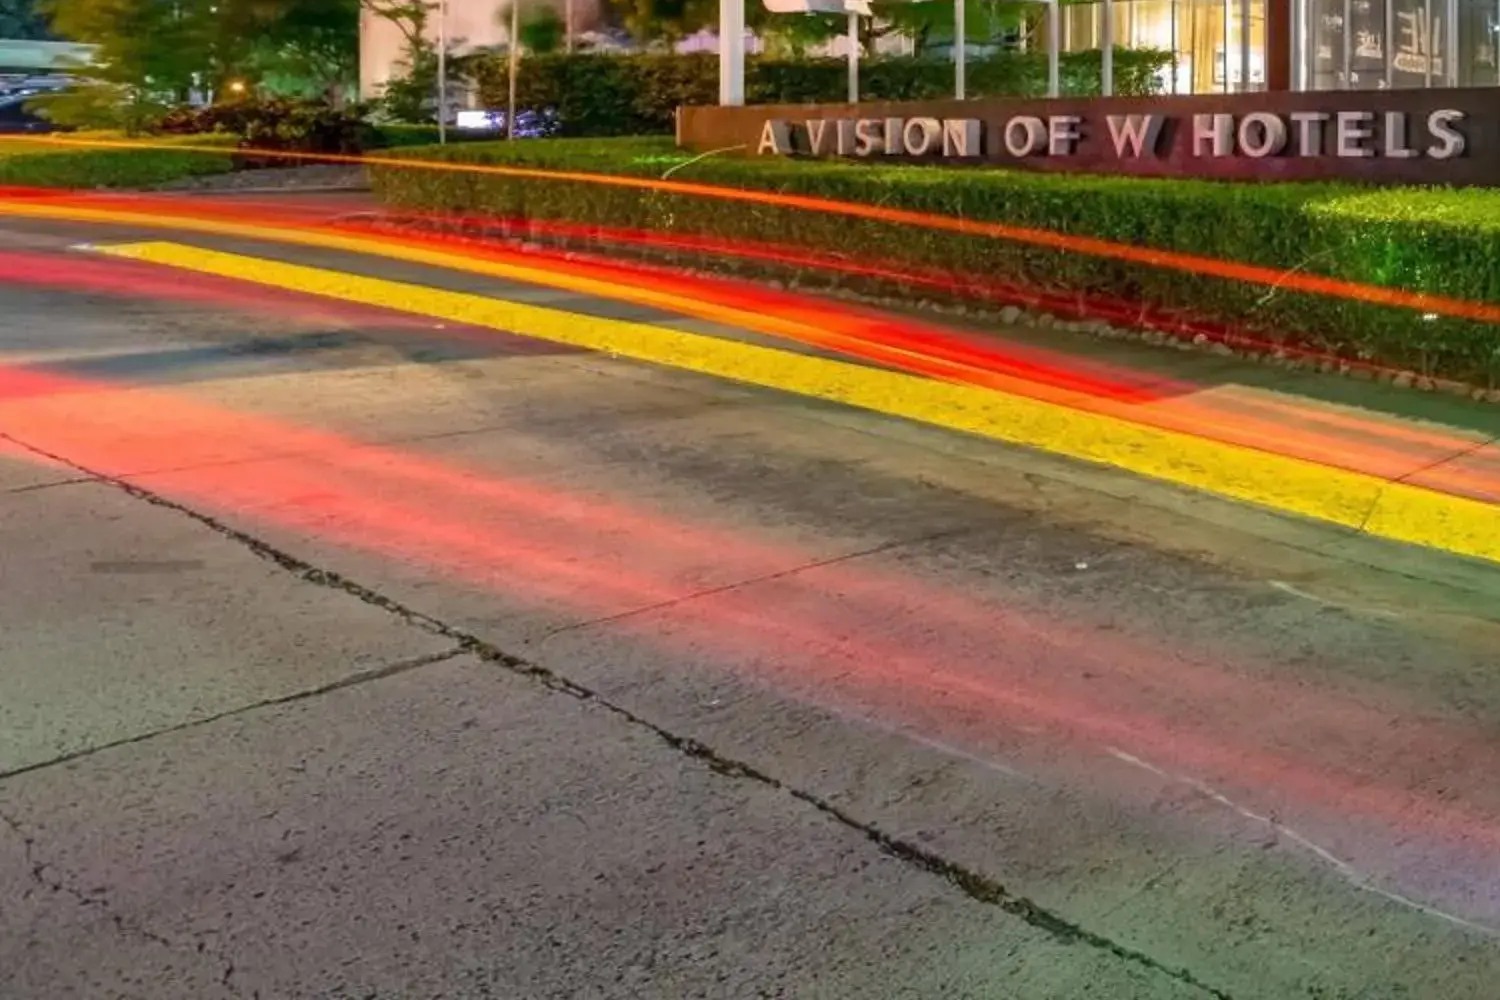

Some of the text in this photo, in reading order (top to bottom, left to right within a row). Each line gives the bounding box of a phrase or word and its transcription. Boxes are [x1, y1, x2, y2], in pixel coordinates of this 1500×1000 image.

[757, 108, 1467, 160] A VISION OF W HOTELS
